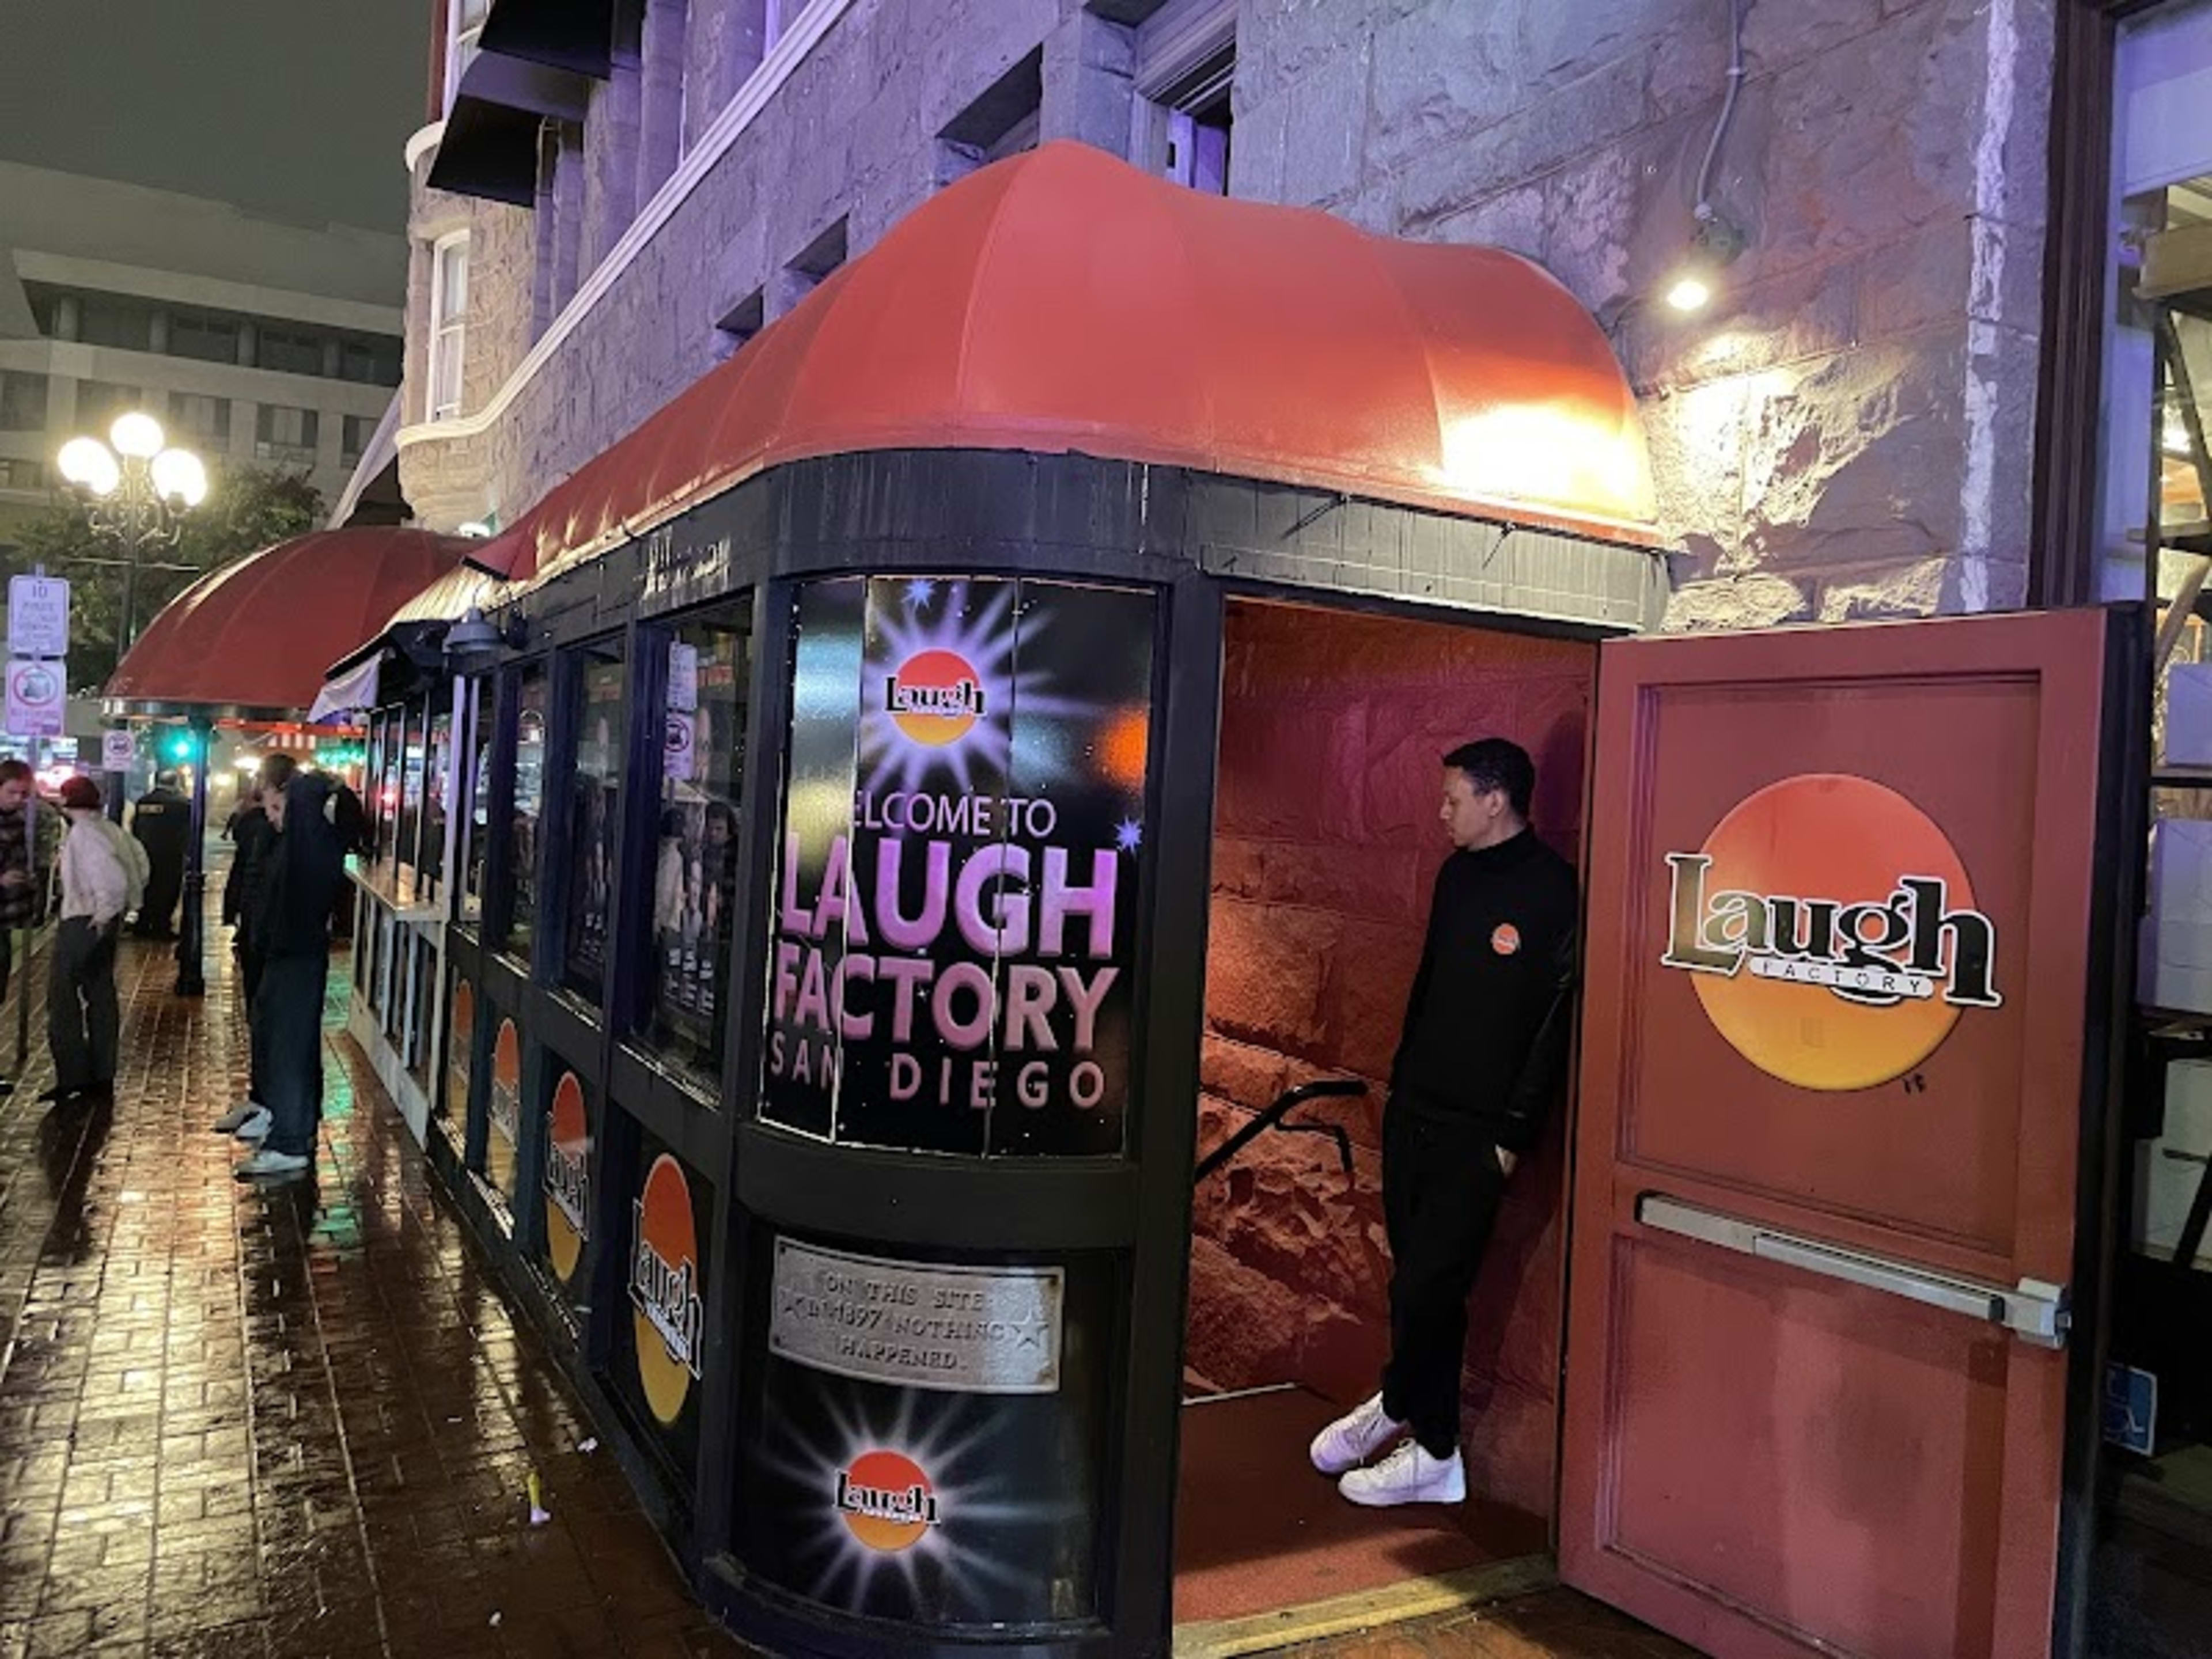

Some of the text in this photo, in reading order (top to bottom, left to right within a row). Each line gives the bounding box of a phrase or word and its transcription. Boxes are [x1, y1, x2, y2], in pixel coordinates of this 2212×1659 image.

[885, 676, 987, 718] Laugh
[854, 790, 1057, 838] ELCOME TO
[782, 832, 1119, 959] LAUGH
[1662, 853, 2002, 1008] Laugh
[774, 939, 1120, 1052] FACTORY
[1763, 961, 1921, 994] FACTORY
[770, 1030, 1105, 1109] SAN DIEGO
[825, 1271, 984, 1311] ON THIS SITE
[836, 1301, 883, 1330] 1897
[893, 1315, 1006, 1343] NOTHING
[837, 1468, 939, 1524] Laugh
